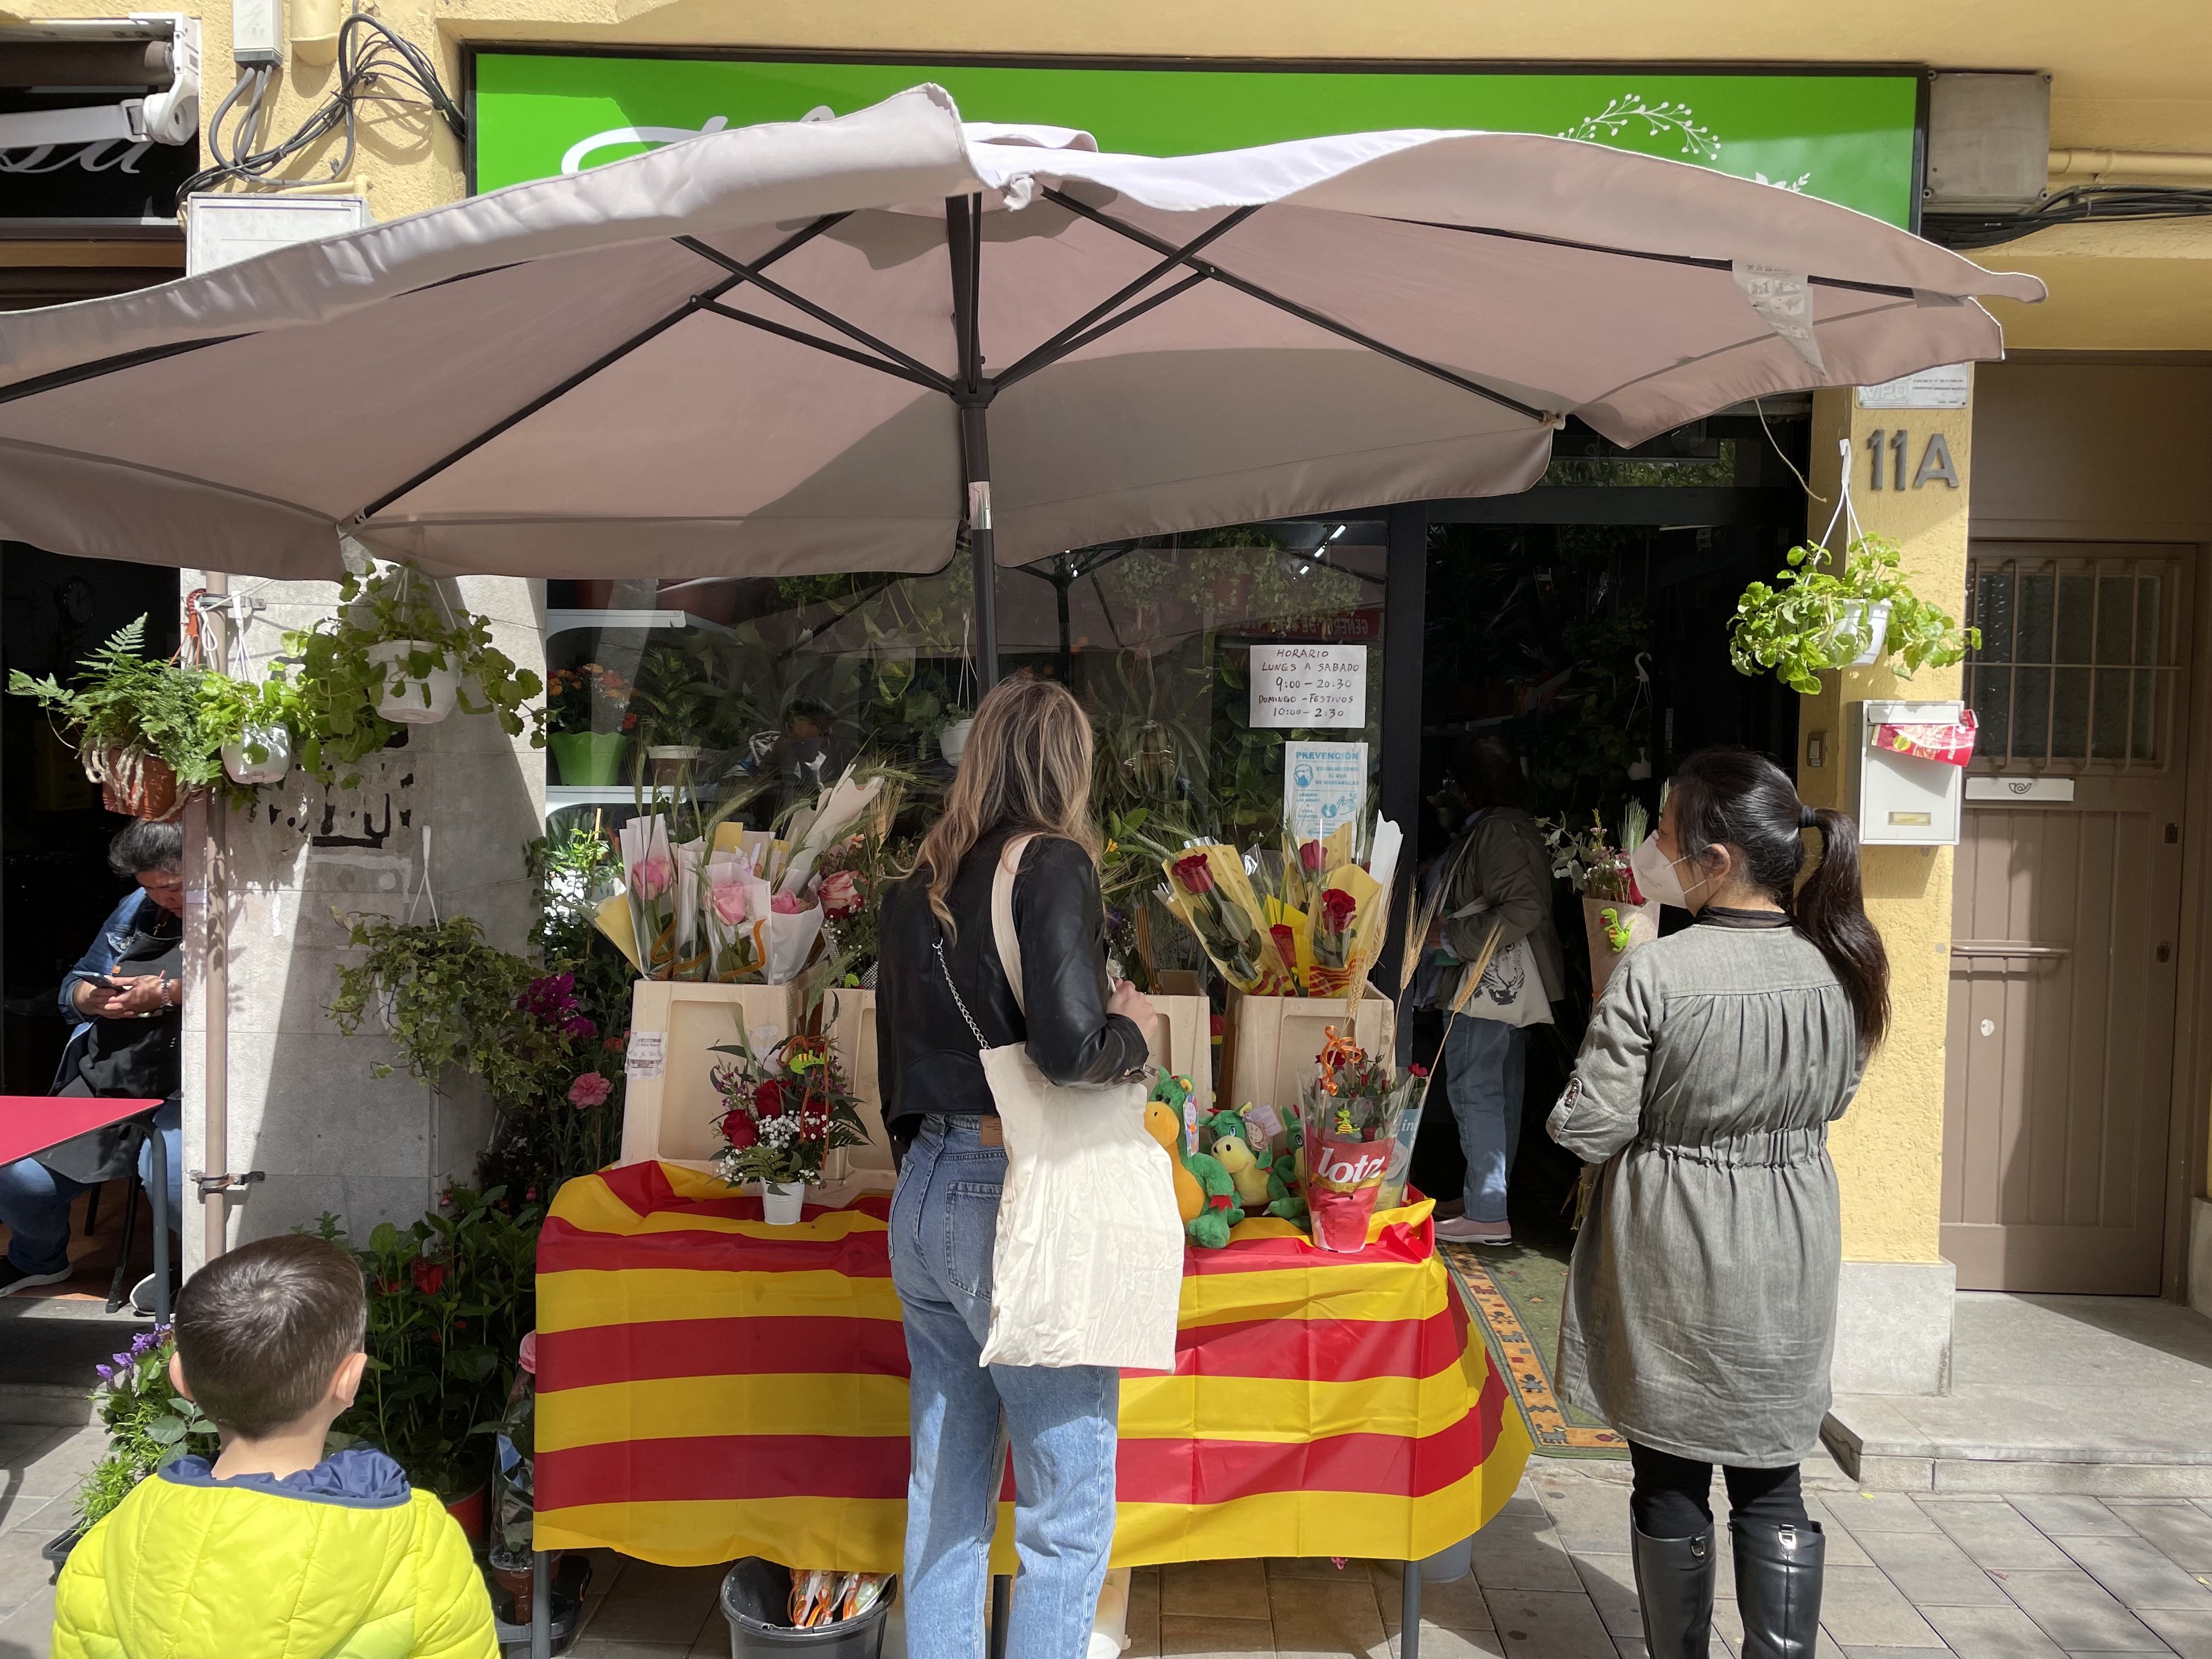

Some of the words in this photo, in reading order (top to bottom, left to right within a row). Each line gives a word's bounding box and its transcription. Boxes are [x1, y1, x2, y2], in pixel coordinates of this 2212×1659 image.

[1866, 428, 1960, 491] 11A
[1277, 648, 1329, 658] HORARIO
[1262, 662, 1296, 672] LUNES
[1304, 662, 1311, 670] A
[1318, 663, 1359, 672] SABADO
[1276, 676, 1301, 692] 9:00
[1316, 678, 1352, 690] 20:30
[1259, 695, 1296, 704] DOMINGO
[1273, 707, 1301, 716] 10:00
[1314, 708, 1344, 718] 2:30
[1295, 751, 1359, 760] PREVENCIÓN
